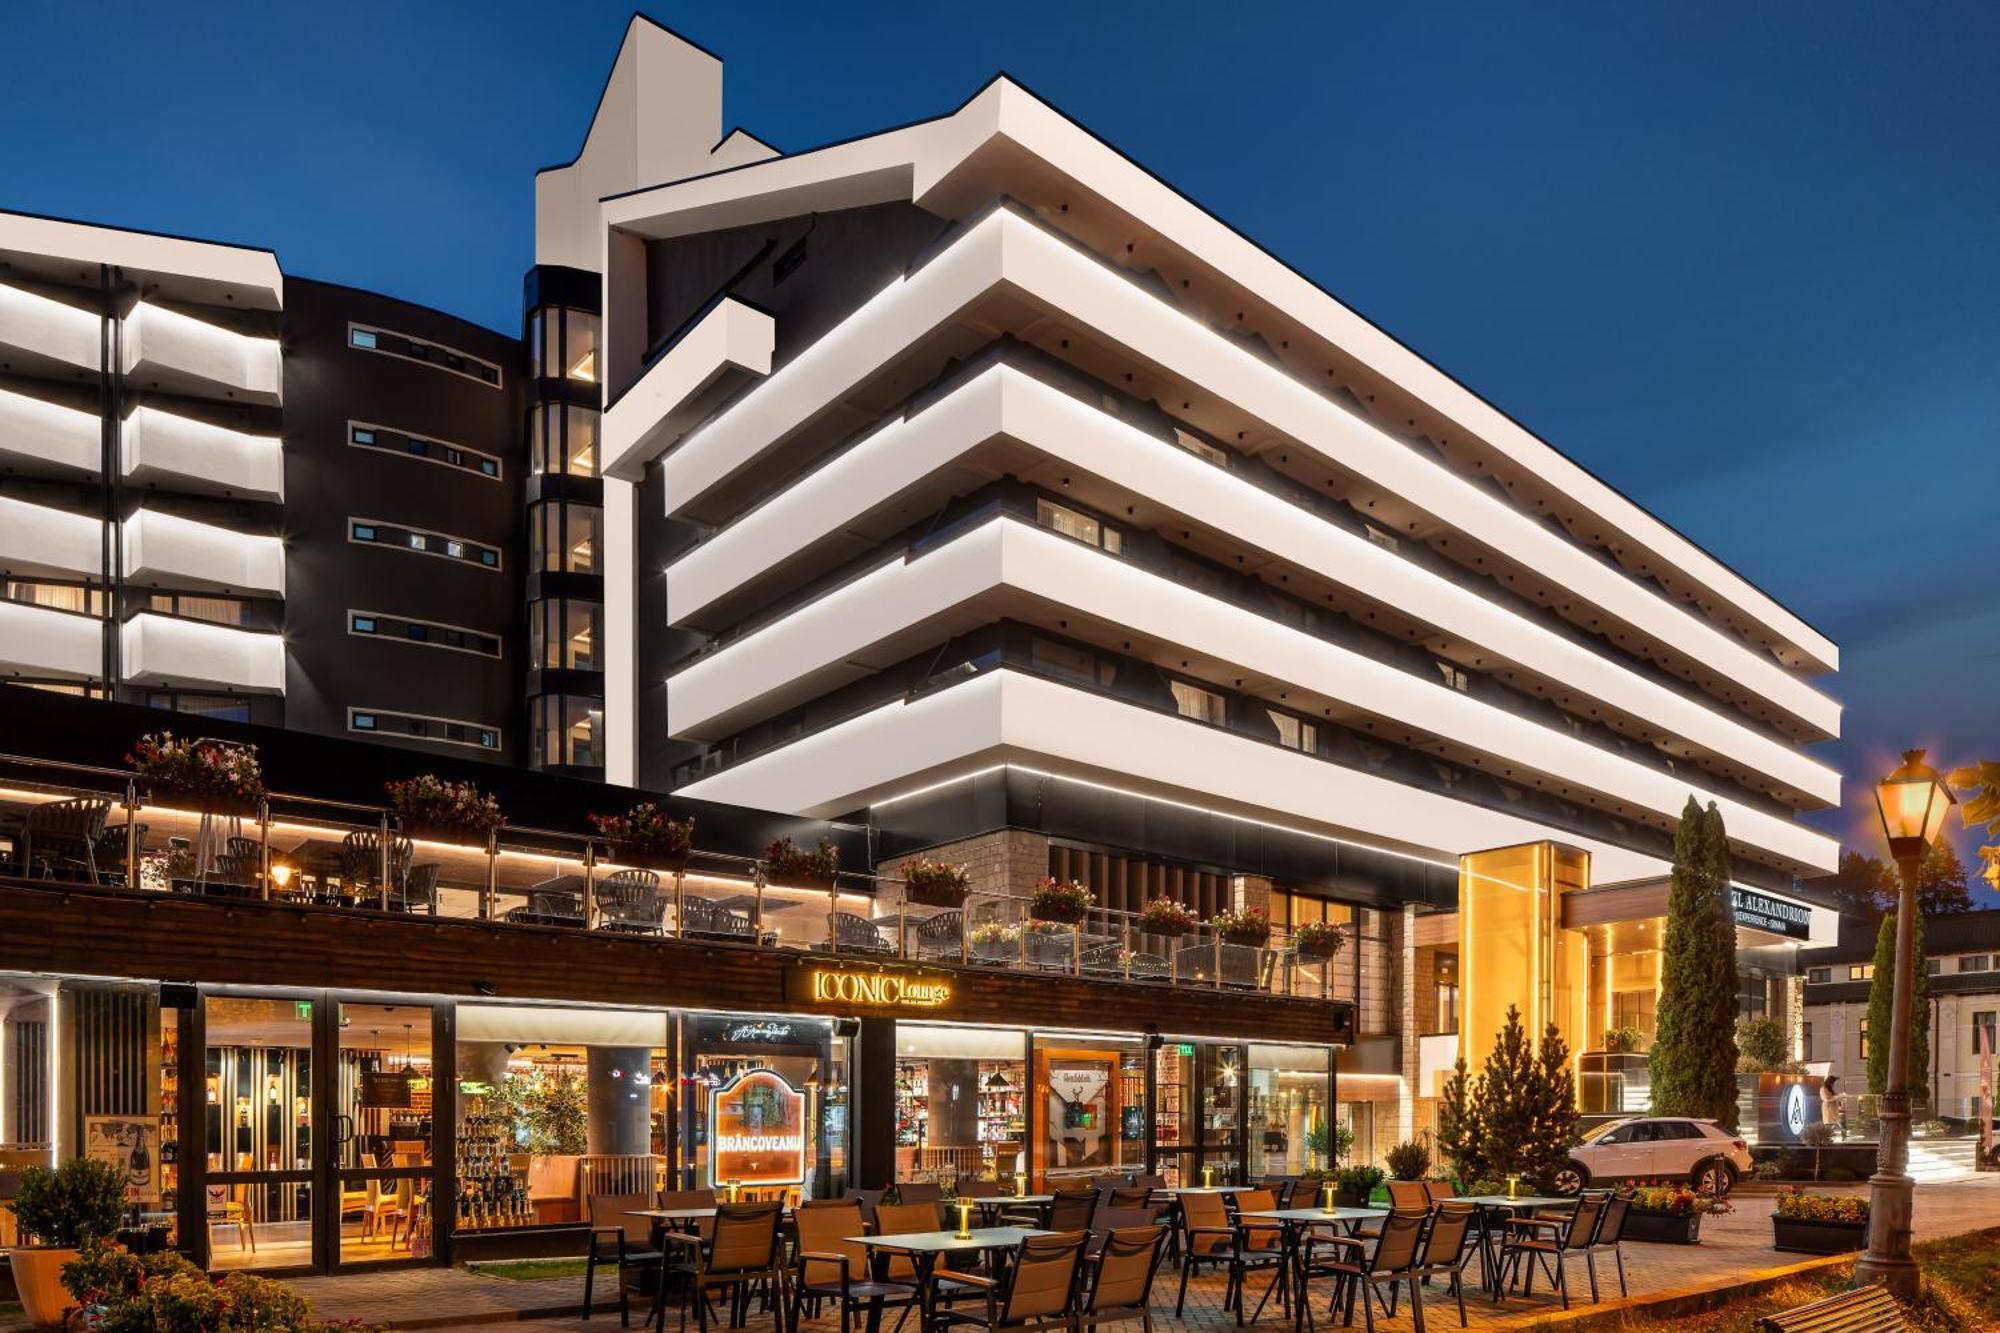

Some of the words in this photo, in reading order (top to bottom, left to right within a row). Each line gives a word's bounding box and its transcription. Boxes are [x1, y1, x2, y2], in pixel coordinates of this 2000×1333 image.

[1746, 895, 1810, 925] ALEXANDRION
[815, 971, 899, 1003] ICONIC
[899, 976, 950, 1005] Lounge
[718, 1132, 801, 1152] BRÂNCOVEANU
